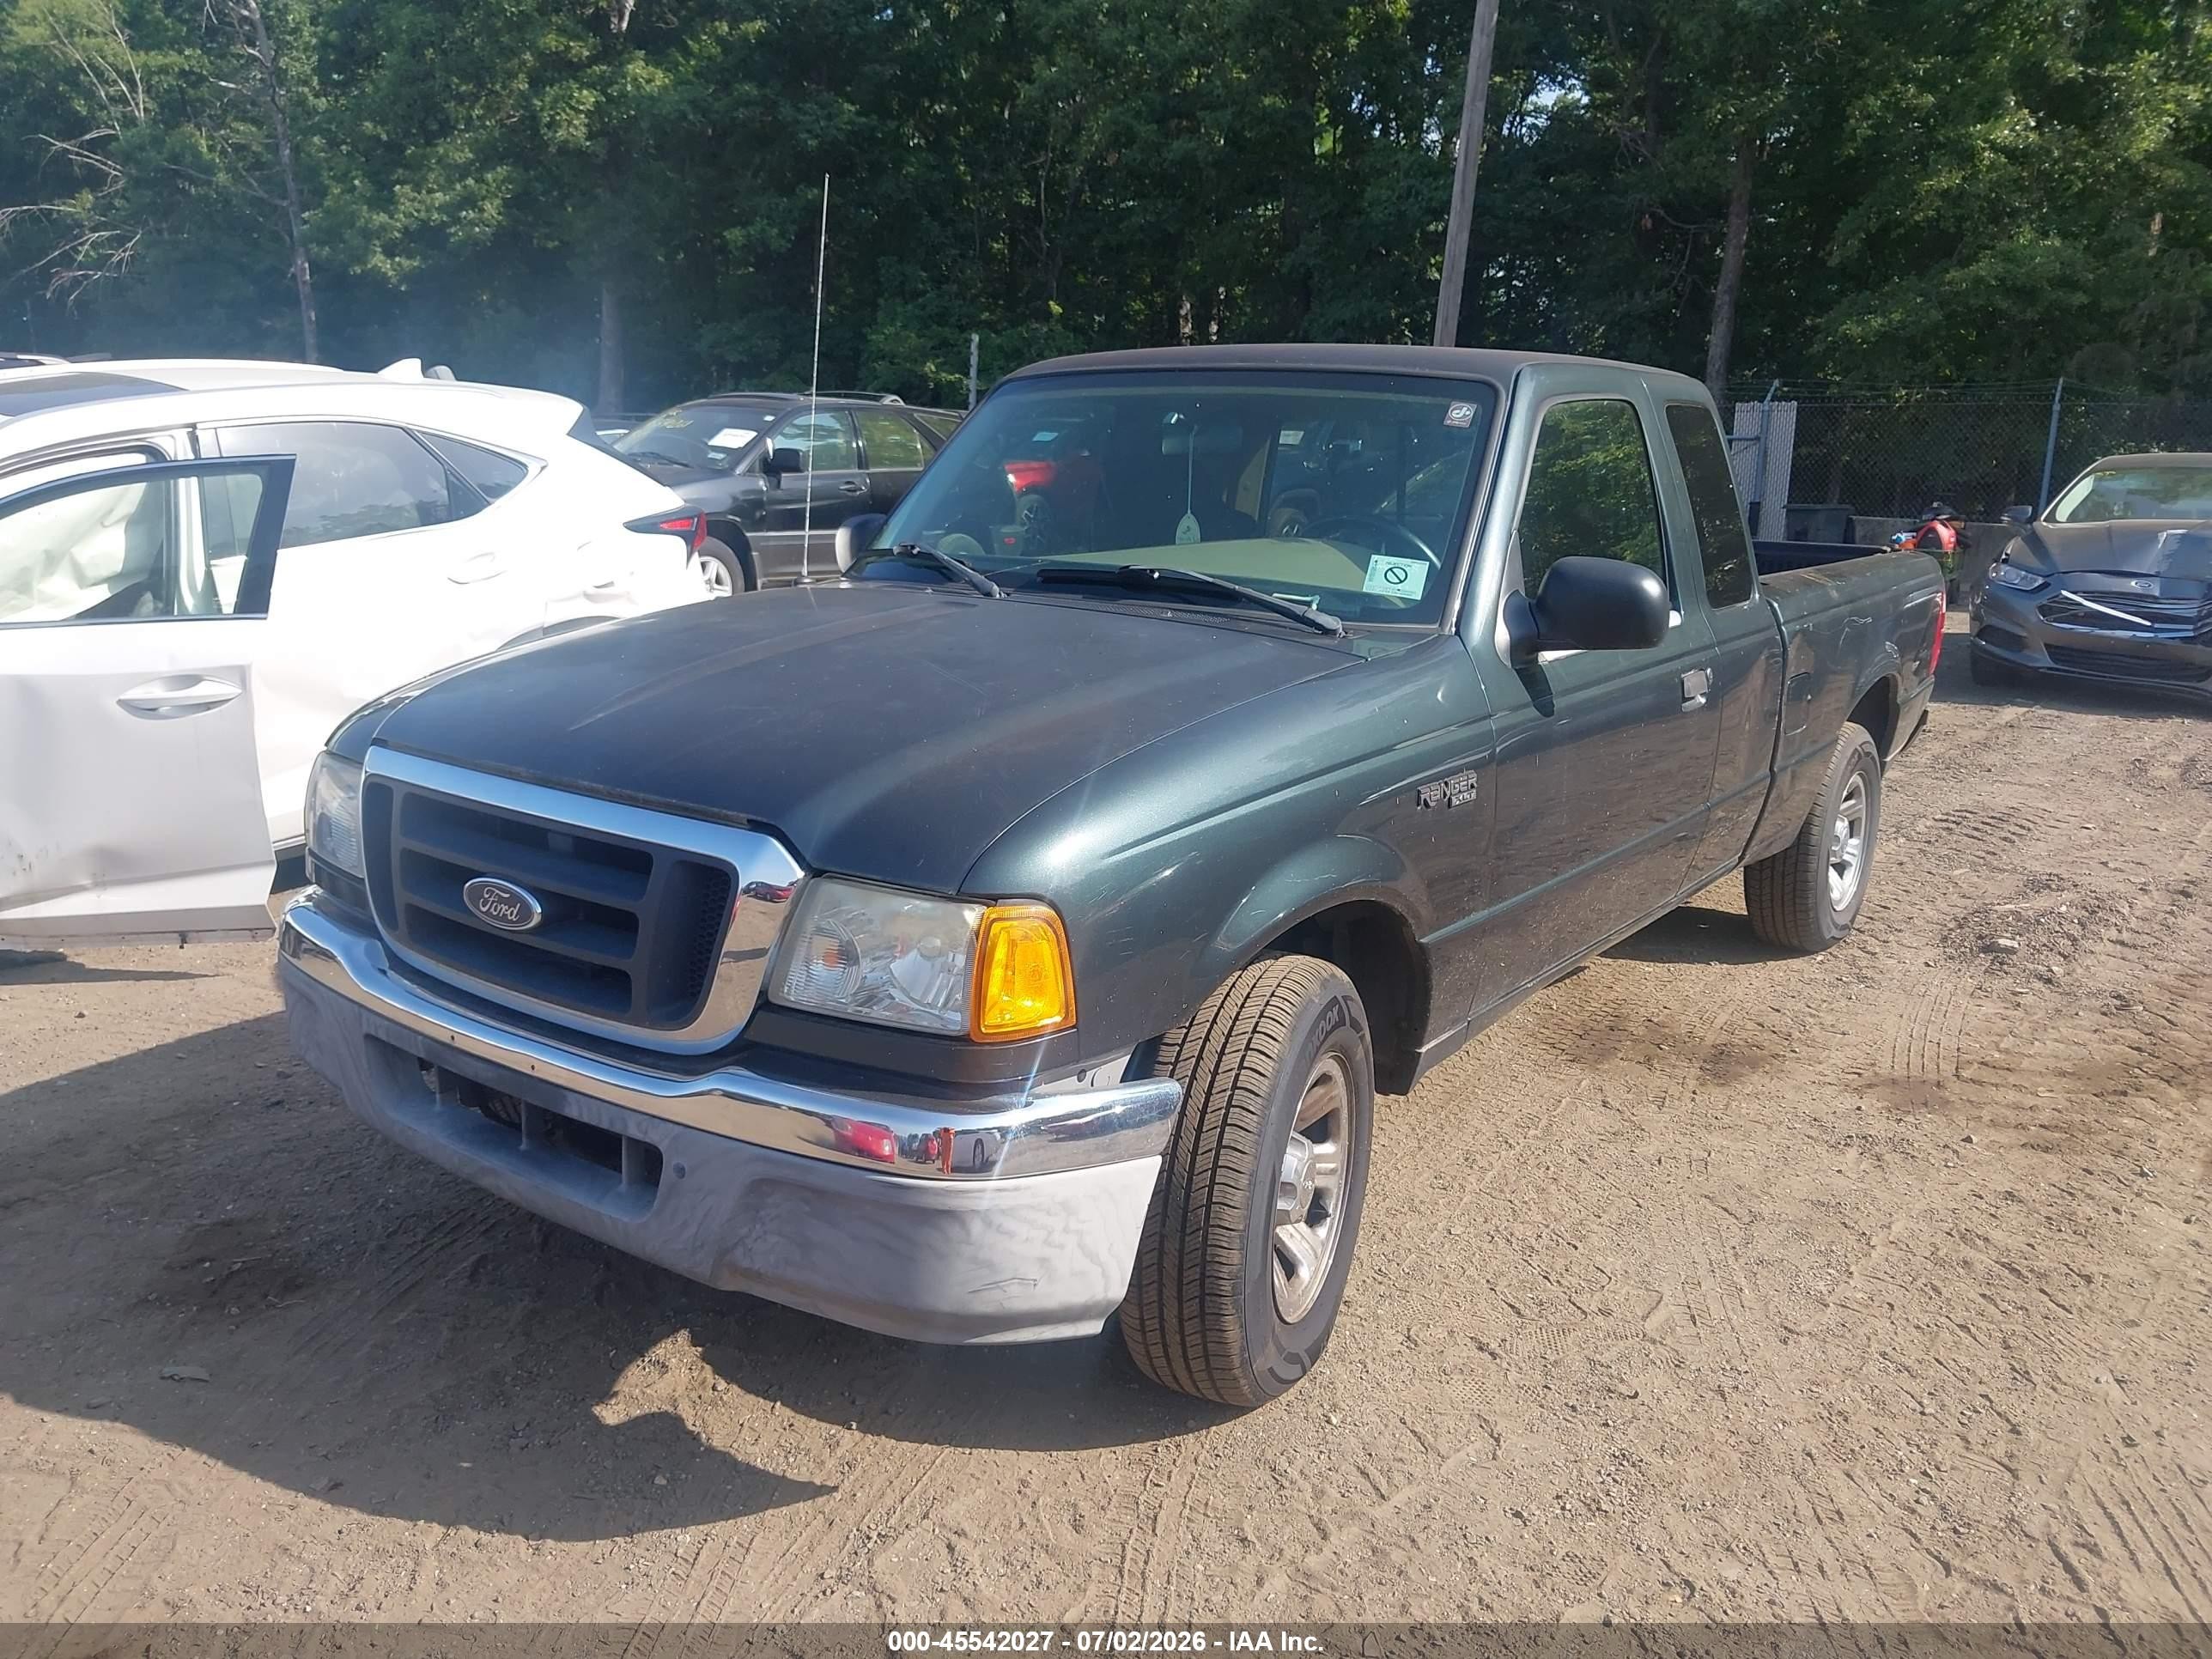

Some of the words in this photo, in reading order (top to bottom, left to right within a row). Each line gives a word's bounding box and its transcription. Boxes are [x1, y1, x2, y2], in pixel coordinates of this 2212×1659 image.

[1417, 770, 1477, 809] RANGER
[1450, 790, 1477, 805] XLT
[479, 886, 520, 921] Ford
